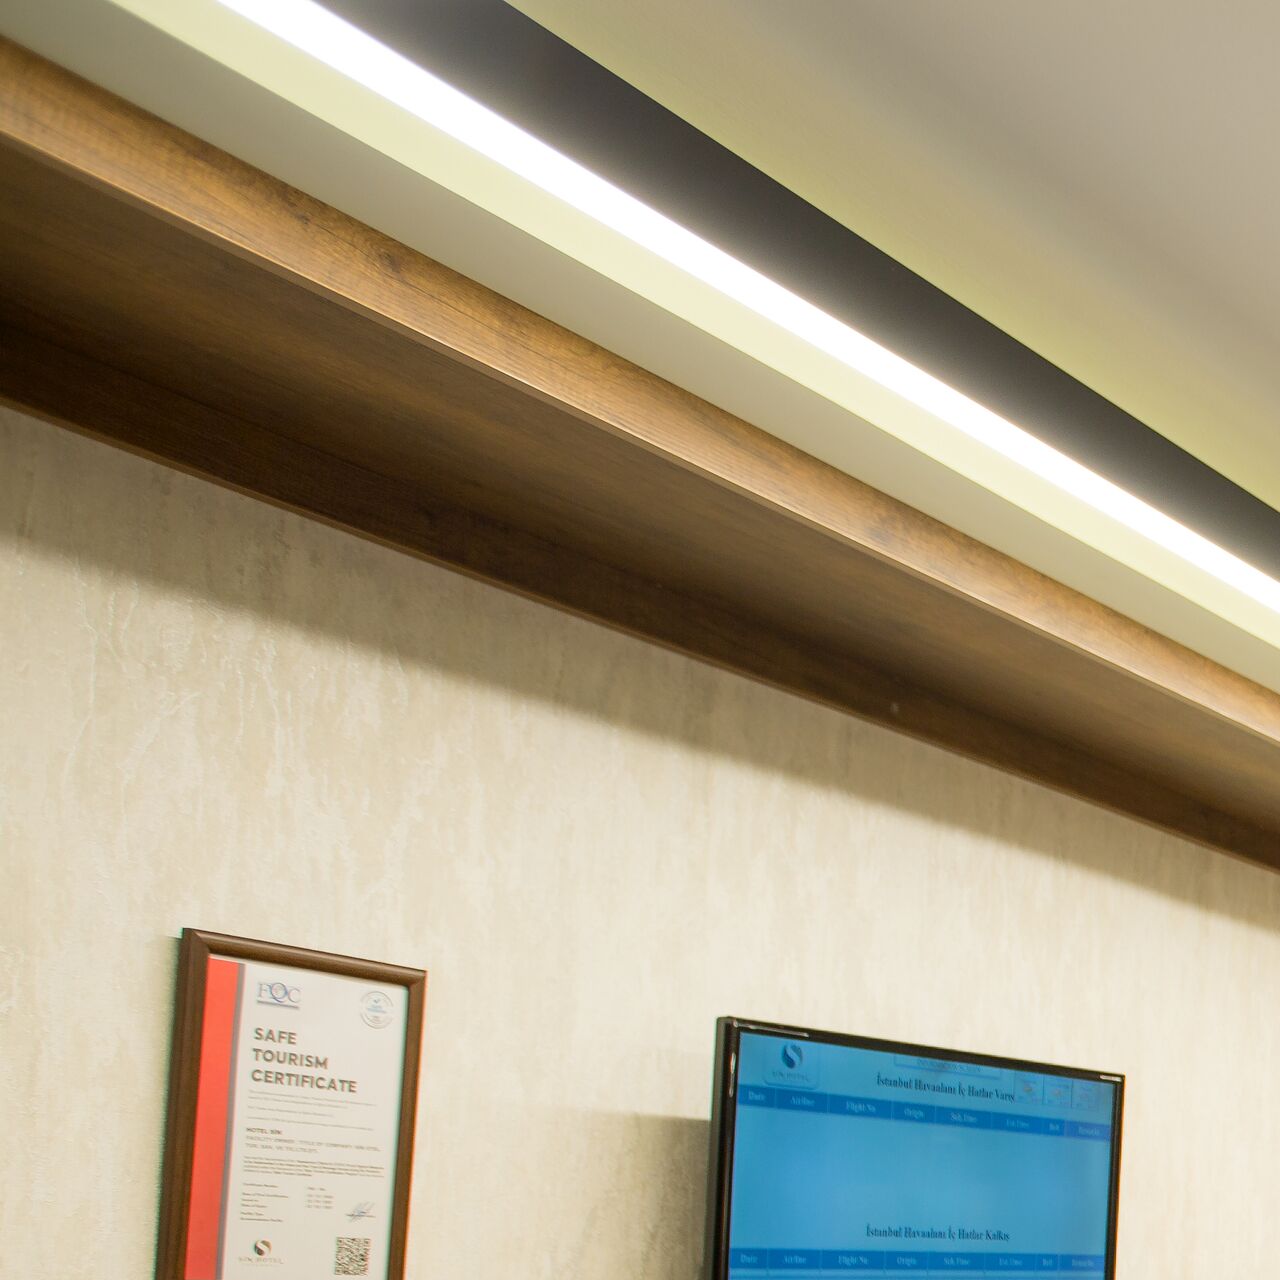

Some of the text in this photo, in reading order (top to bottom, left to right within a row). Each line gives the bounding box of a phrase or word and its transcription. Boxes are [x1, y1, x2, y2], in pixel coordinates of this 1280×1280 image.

[254, 1027, 297, 1045] SAFE
[252, 1047, 329, 1070] TOURISM
[251, 1069, 358, 1093] CERTIFICATE
